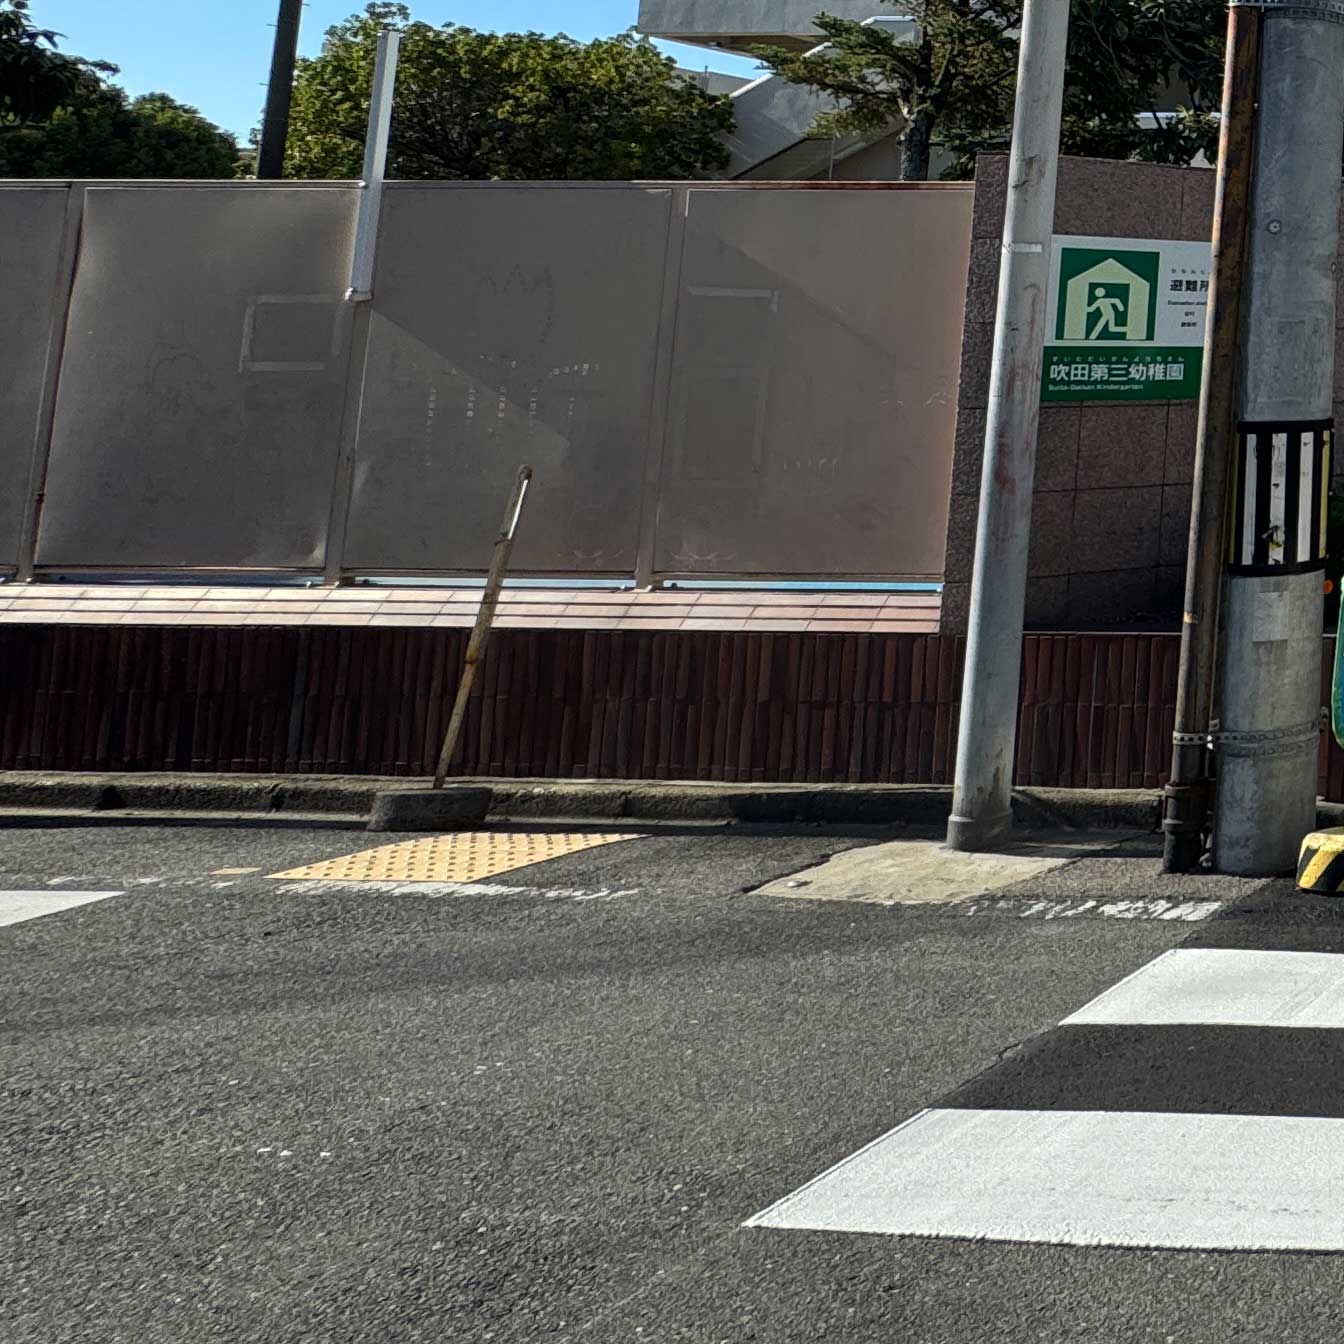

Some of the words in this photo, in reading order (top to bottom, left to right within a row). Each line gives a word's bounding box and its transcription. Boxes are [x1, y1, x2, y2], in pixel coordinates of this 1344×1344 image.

[1050, 363, 1184, 381] 吹田第三幼稚園
